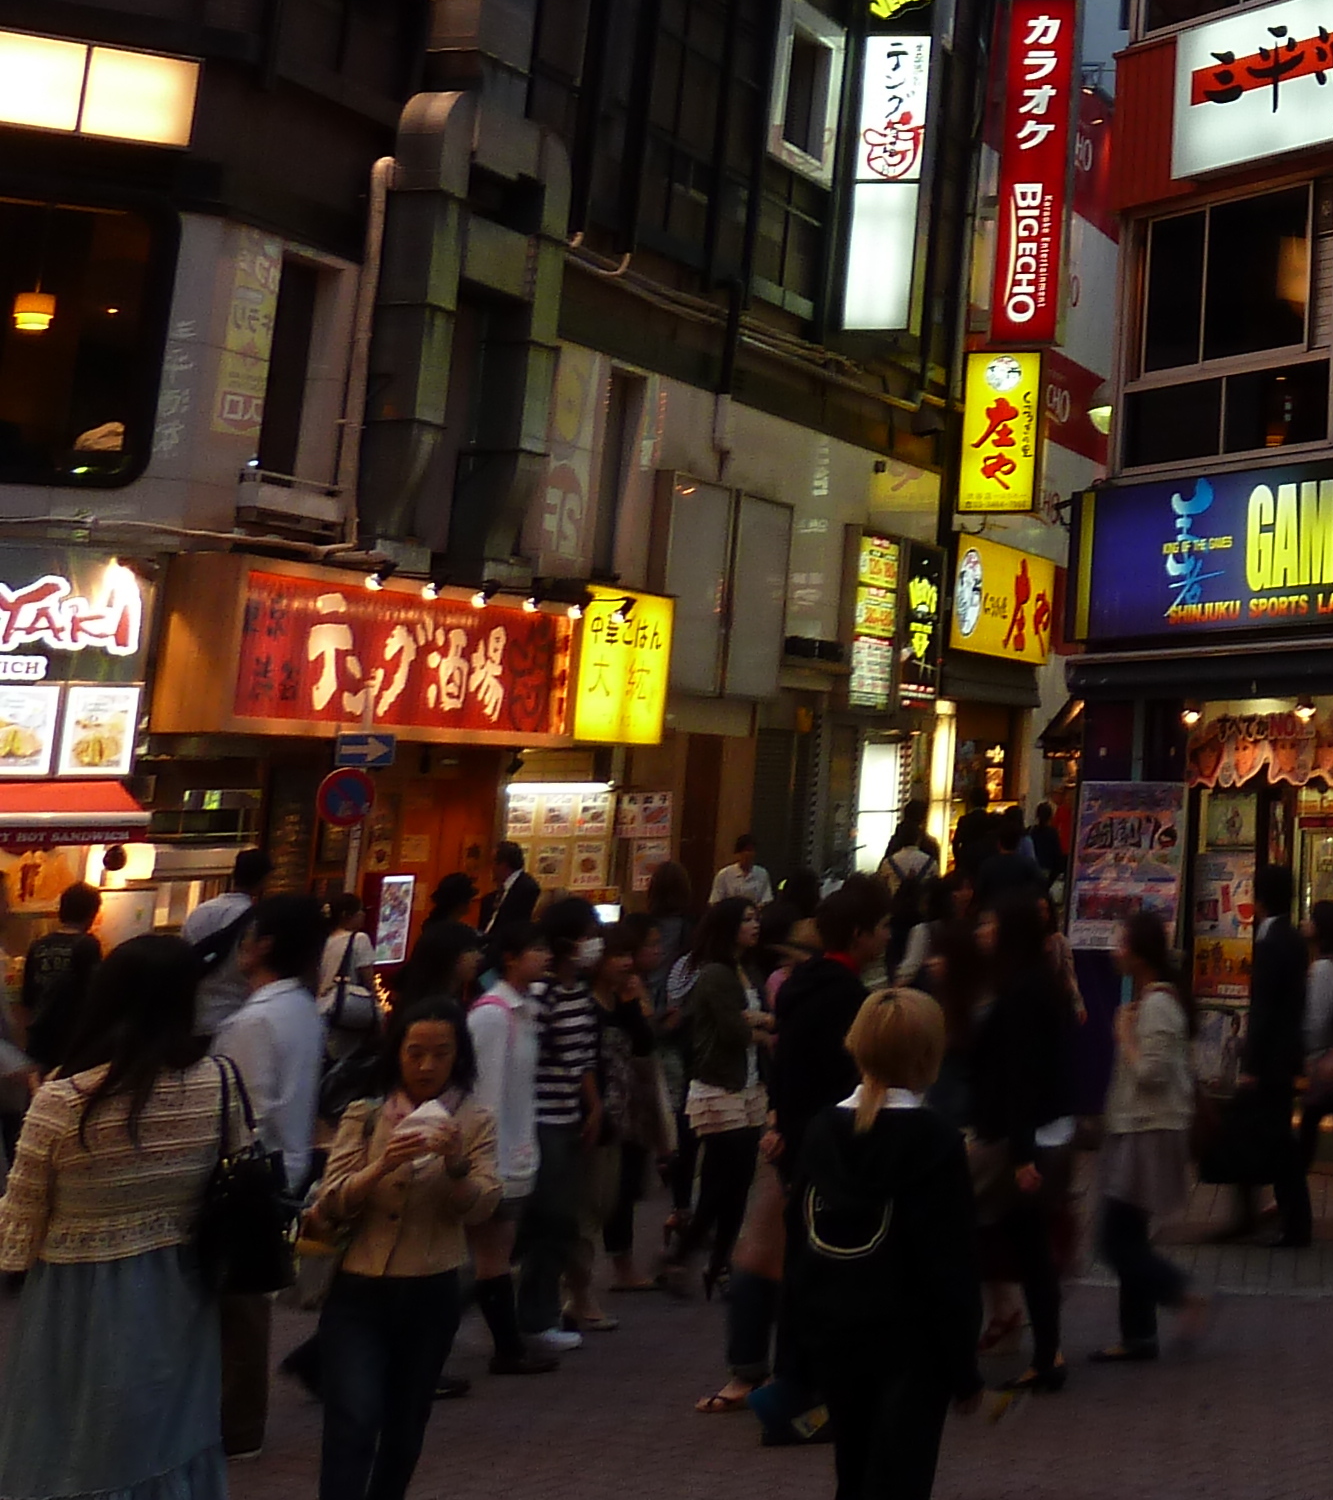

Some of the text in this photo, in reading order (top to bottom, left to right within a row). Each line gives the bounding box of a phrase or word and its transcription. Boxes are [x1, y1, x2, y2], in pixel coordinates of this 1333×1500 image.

[1016, 14, 1062, 150] カラオケ
[1006, 182, 1043, 323] BIG ECHO
[1036, 194, 1054, 308] Karaoke Entertainment
[970, 397, 1020, 490] 庄や
[1002, 557, 1051, 658] 庄や
[1168, 600, 1241, 624] SHINJUKU
[1249, 594, 1309, 619] SPORTS
[15, 831, 46, 843] HOT
[50, 830, 130, 843] SANDWICH
